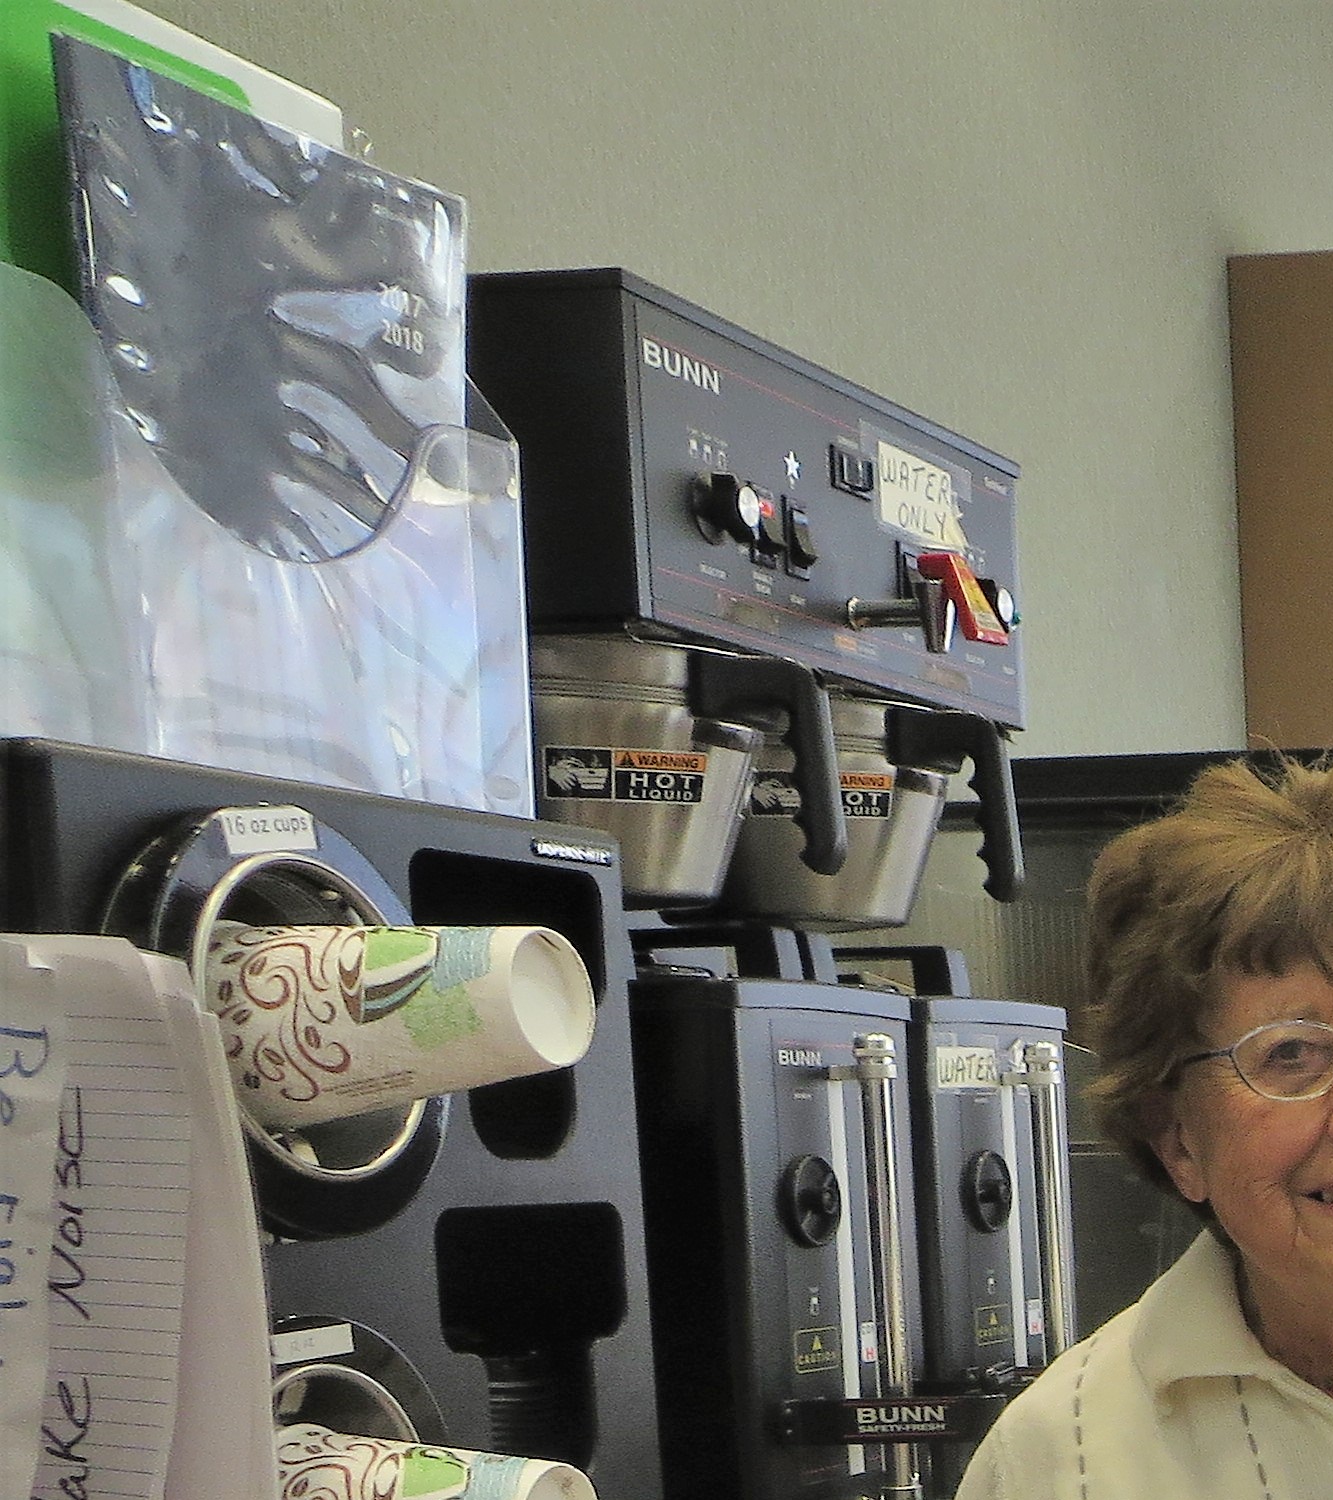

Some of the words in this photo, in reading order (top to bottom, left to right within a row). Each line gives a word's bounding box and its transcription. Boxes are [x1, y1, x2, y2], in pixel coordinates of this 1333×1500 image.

[381, 319, 425, 355] 2018
[641, 336, 720, 396] BUNN
[881, 453, 952, 506] WATER
[898, 502, 947, 541] ONLY
[637, 753, 699, 769] WARNING
[629, 771, 696, 790] HOT
[840, 775, 885, 788] ARNING
[628, 789, 694, 802] LIQUID
[845, 792, 882, 807] OT
[225, 815, 246, 836] 16
[250, 819, 271, 834] oz
[273, 816, 309, 836] cups
[777, 1049, 822, 1067] BUNN
[938, 1053, 998, 1083] WATER
[856, 1405, 946, 1424] BUNN
